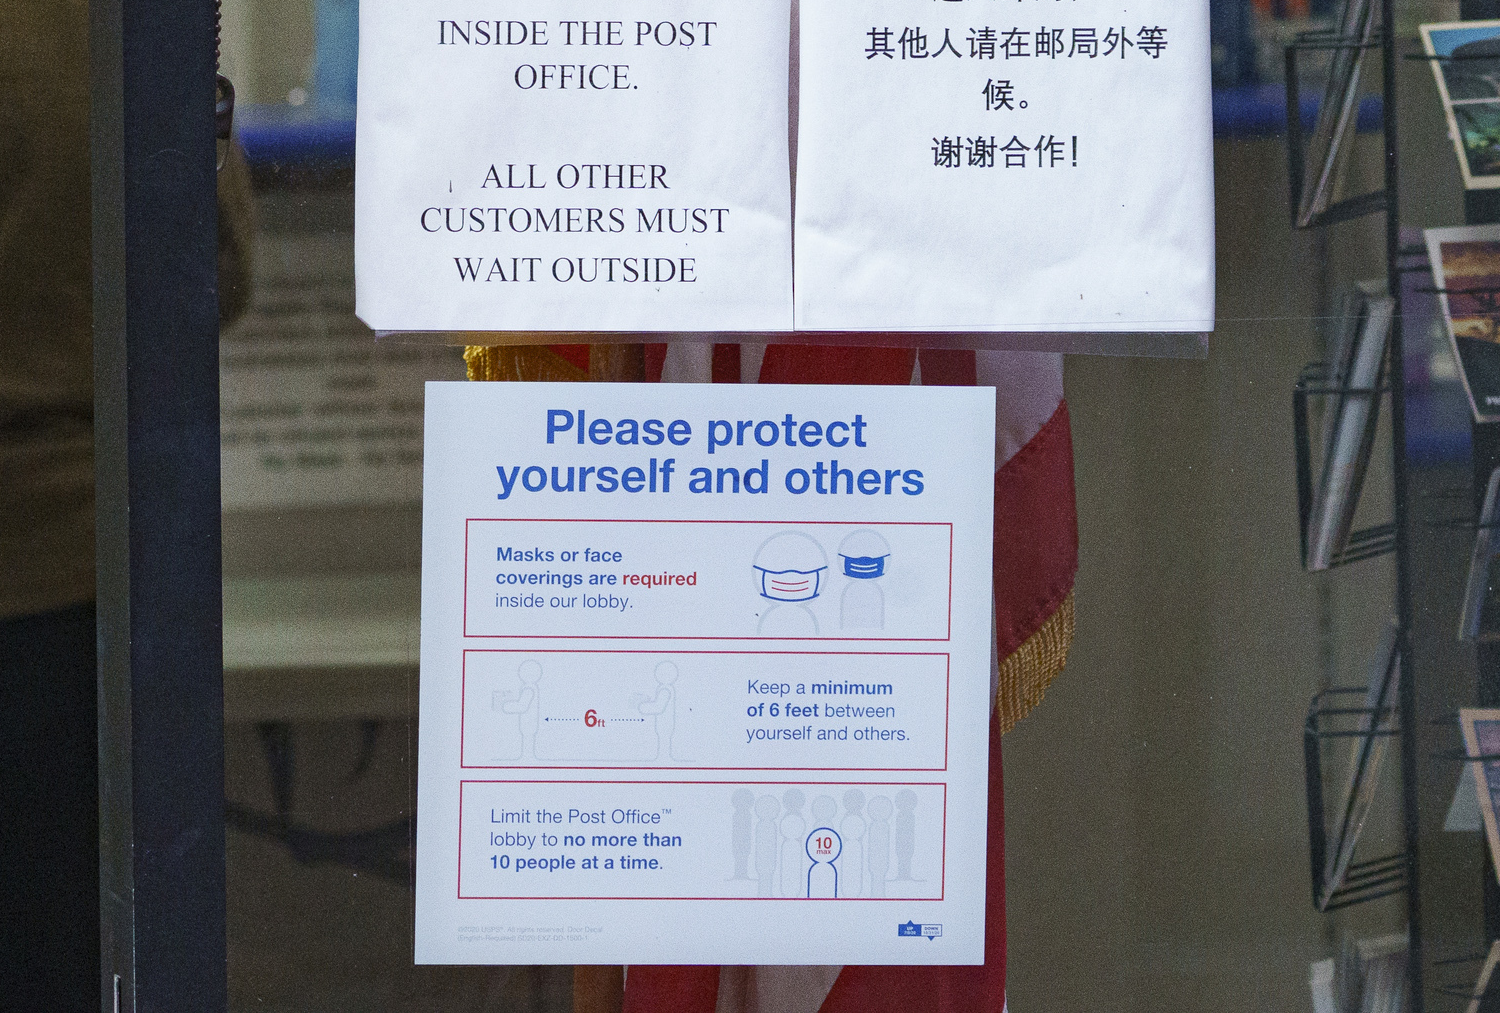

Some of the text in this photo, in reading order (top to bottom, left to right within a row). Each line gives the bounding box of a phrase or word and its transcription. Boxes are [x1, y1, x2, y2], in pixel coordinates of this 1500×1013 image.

[437, 20, 718, 48] INSIDE THE POST
[864, 25, 1169, 61] 其他人请在邮局外等
[514, 64, 639, 91] OFFICE.
[981, 78, 1030, 112] 候。
[931, 135, 1080, 169] 谢谢合作！
[481, 163, 671, 190] ALL OTHER
[420, 207, 730, 235] CUSTOMERS MUST
[453, 257, 698, 284] WAIT OUTSIDE
[546, 409, 868, 455] Please protect
[496, 458, 925, 501] yourself and others
[496, 546, 623, 563] Masks or face
[495, 570, 697, 589] coverings are required
[495, 592, 633, 612] inside our lobby.
[747, 679, 893, 698] Keep a minimum
[747, 702, 896, 719] of 6 feet between
[746, 726, 911, 744] yourself and others.
[490, 808, 531, 824] Limit
[536, 809, 563, 824] the
[568, 808, 606, 824] Post
[490, 831, 682, 850] lobby to no more than
[815, 836, 833, 849] 10
[490, 854, 663, 873] 10 people at a time.
